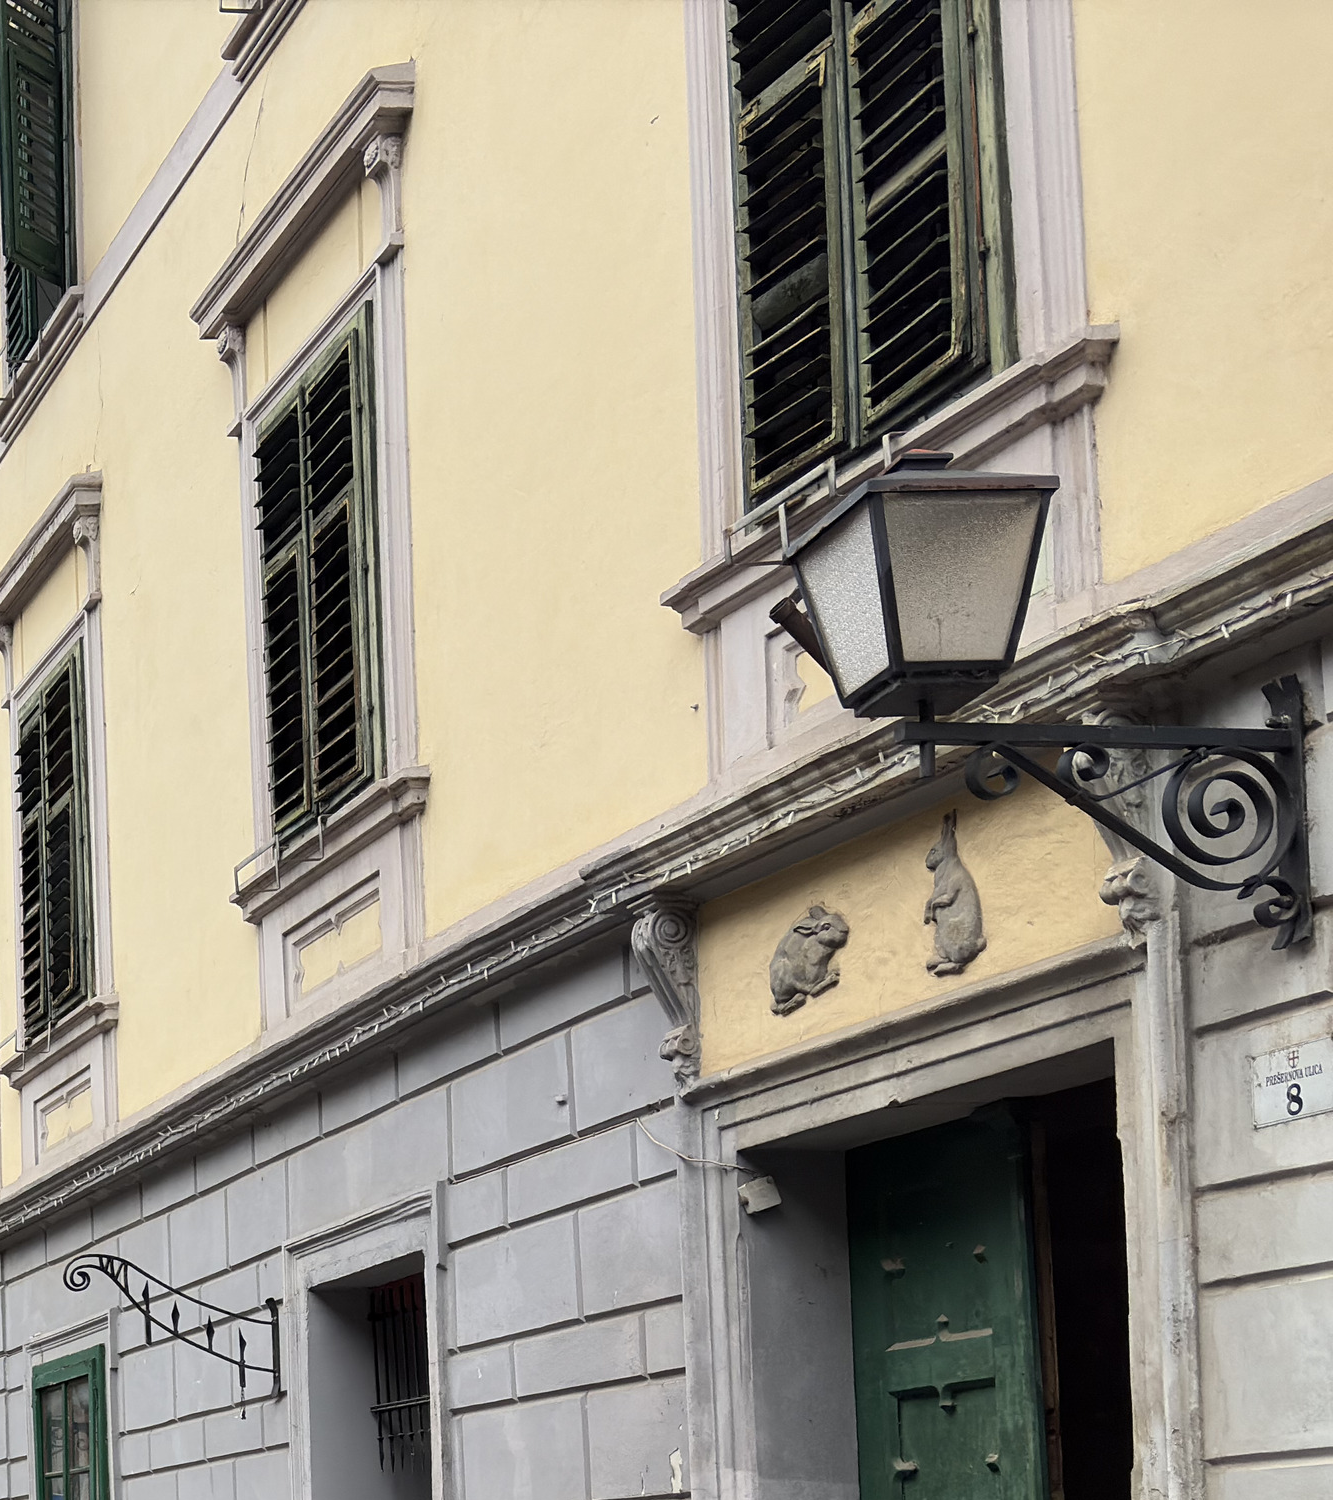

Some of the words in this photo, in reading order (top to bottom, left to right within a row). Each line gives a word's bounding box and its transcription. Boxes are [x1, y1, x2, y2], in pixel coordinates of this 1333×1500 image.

[1265, 1067, 1304, 1088] PREŠERNOVA
[1304, 1063, 1323, 1078] ULICA
[1286, 1083, 1304, 1116] 8
